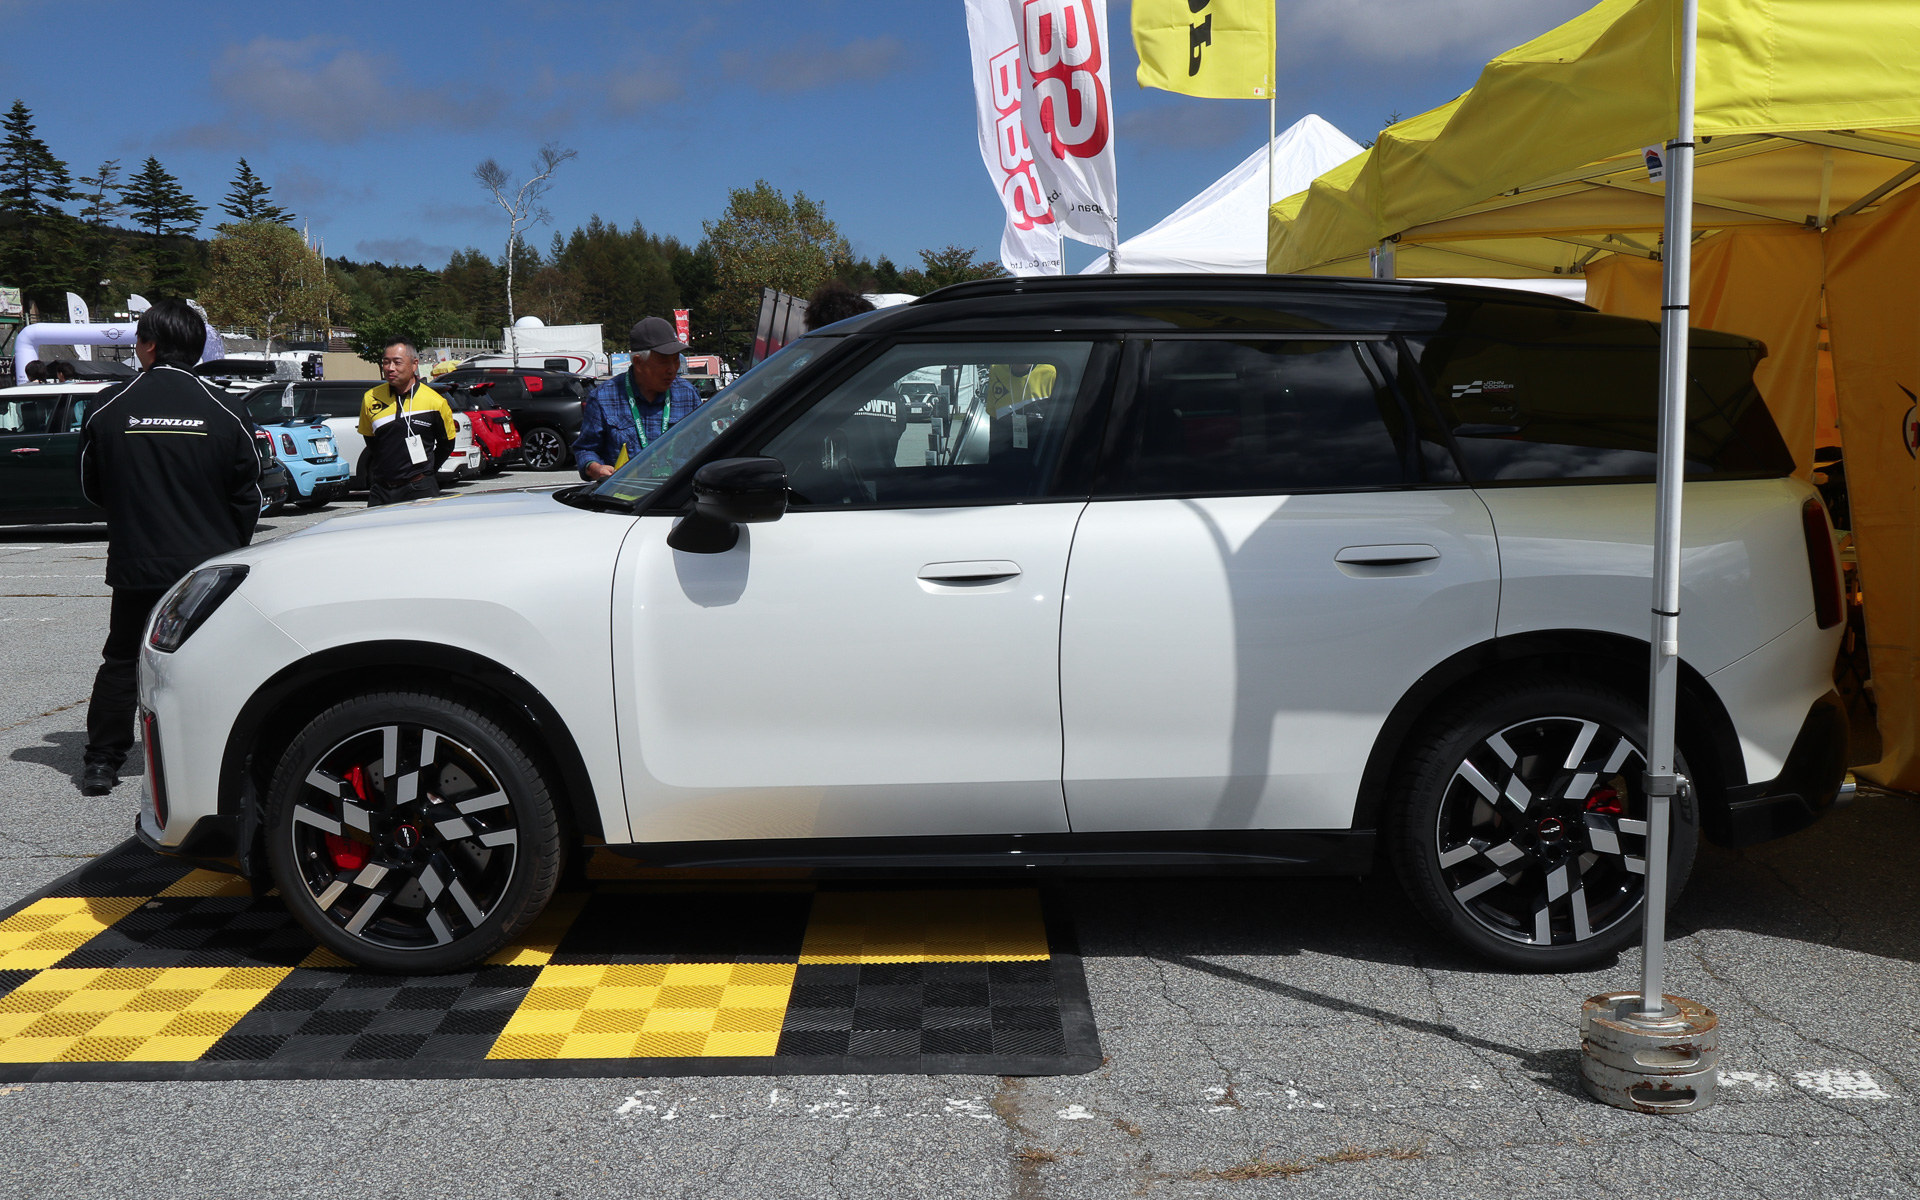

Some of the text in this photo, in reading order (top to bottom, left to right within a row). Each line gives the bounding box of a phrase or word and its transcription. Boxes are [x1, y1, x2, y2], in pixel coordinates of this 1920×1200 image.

[140, 418, 204, 427] DUNLOP
[858, 399, 897, 415] OWTH
[271, 747, 304, 816] DUNLOP
[1425, 758, 1447, 790] WEATHER
[1416, 844, 1448, 910] DUNLOP
